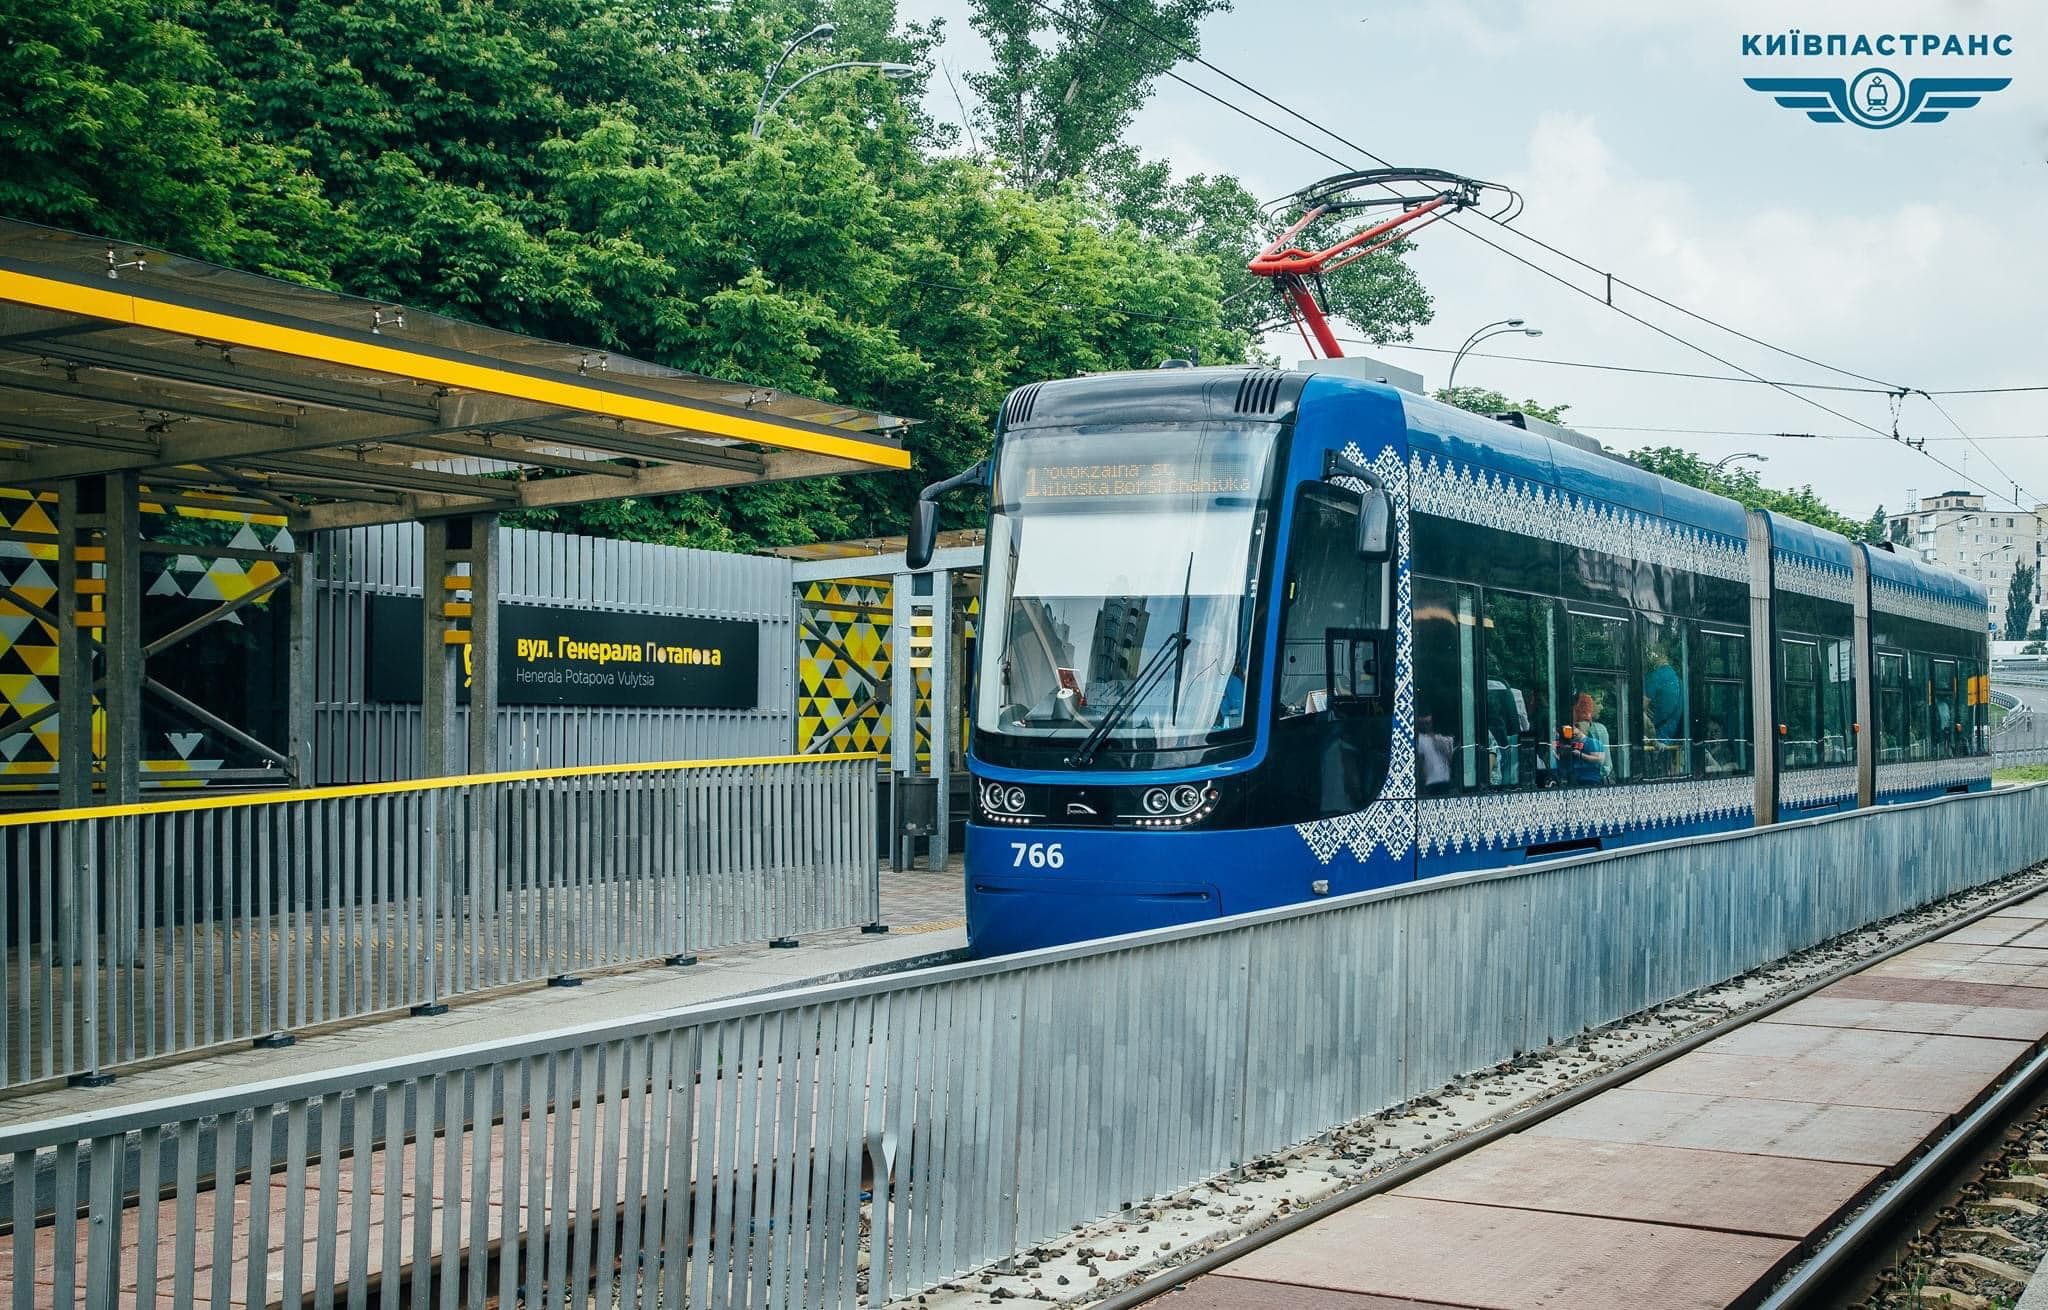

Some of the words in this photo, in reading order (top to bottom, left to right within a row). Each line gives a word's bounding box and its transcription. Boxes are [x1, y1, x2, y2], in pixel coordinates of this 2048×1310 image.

[517, 639, 553, 662] вул.
[558, 635, 642, 664] Генерала
[646, 642, 722, 666] Потапова
[516, 668, 562, 685] Henerala
[565, 670, 615, 687] Potapova
[617, 671, 655, 689] Vulytsia
[1010, 842, 1064, 869] 766
